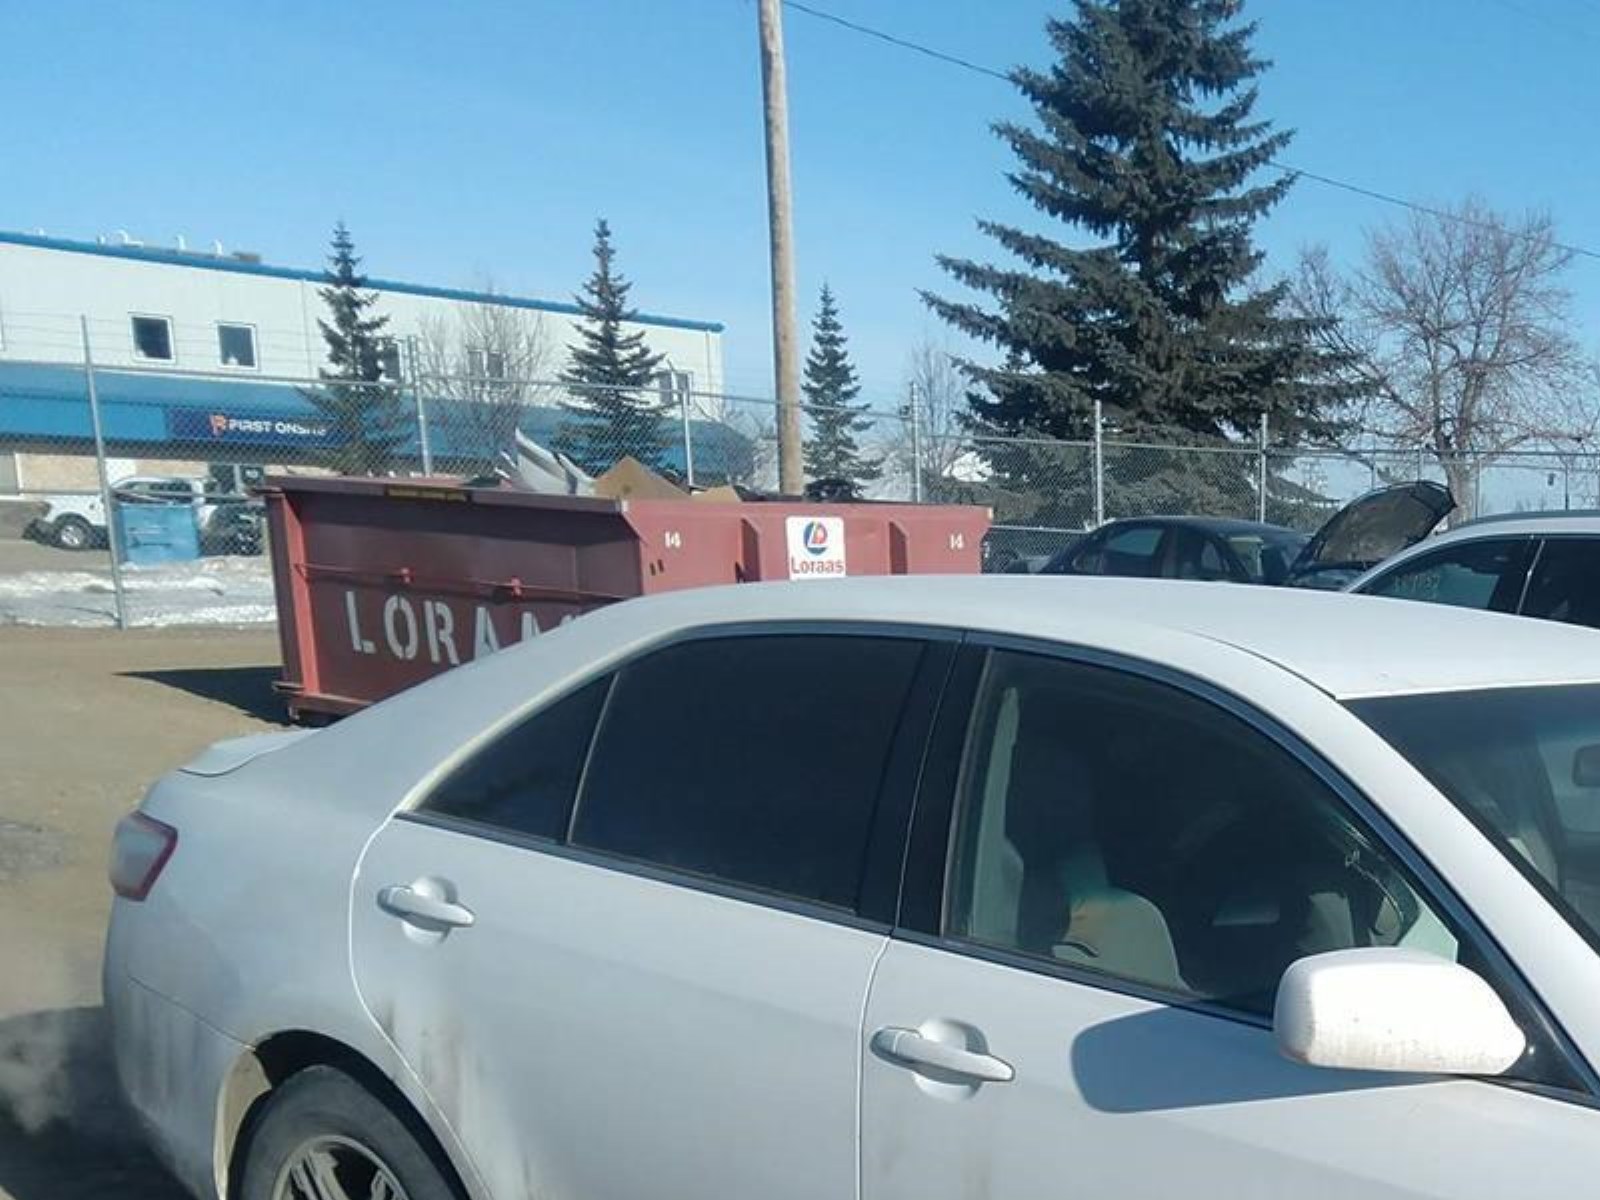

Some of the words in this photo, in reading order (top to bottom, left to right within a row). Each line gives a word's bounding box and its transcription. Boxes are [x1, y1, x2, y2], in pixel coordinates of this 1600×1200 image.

[228, 418, 273, 433] FIRST
[790, 556, 844, 575] Loraas
[345, 590, 578, 666] LORA
